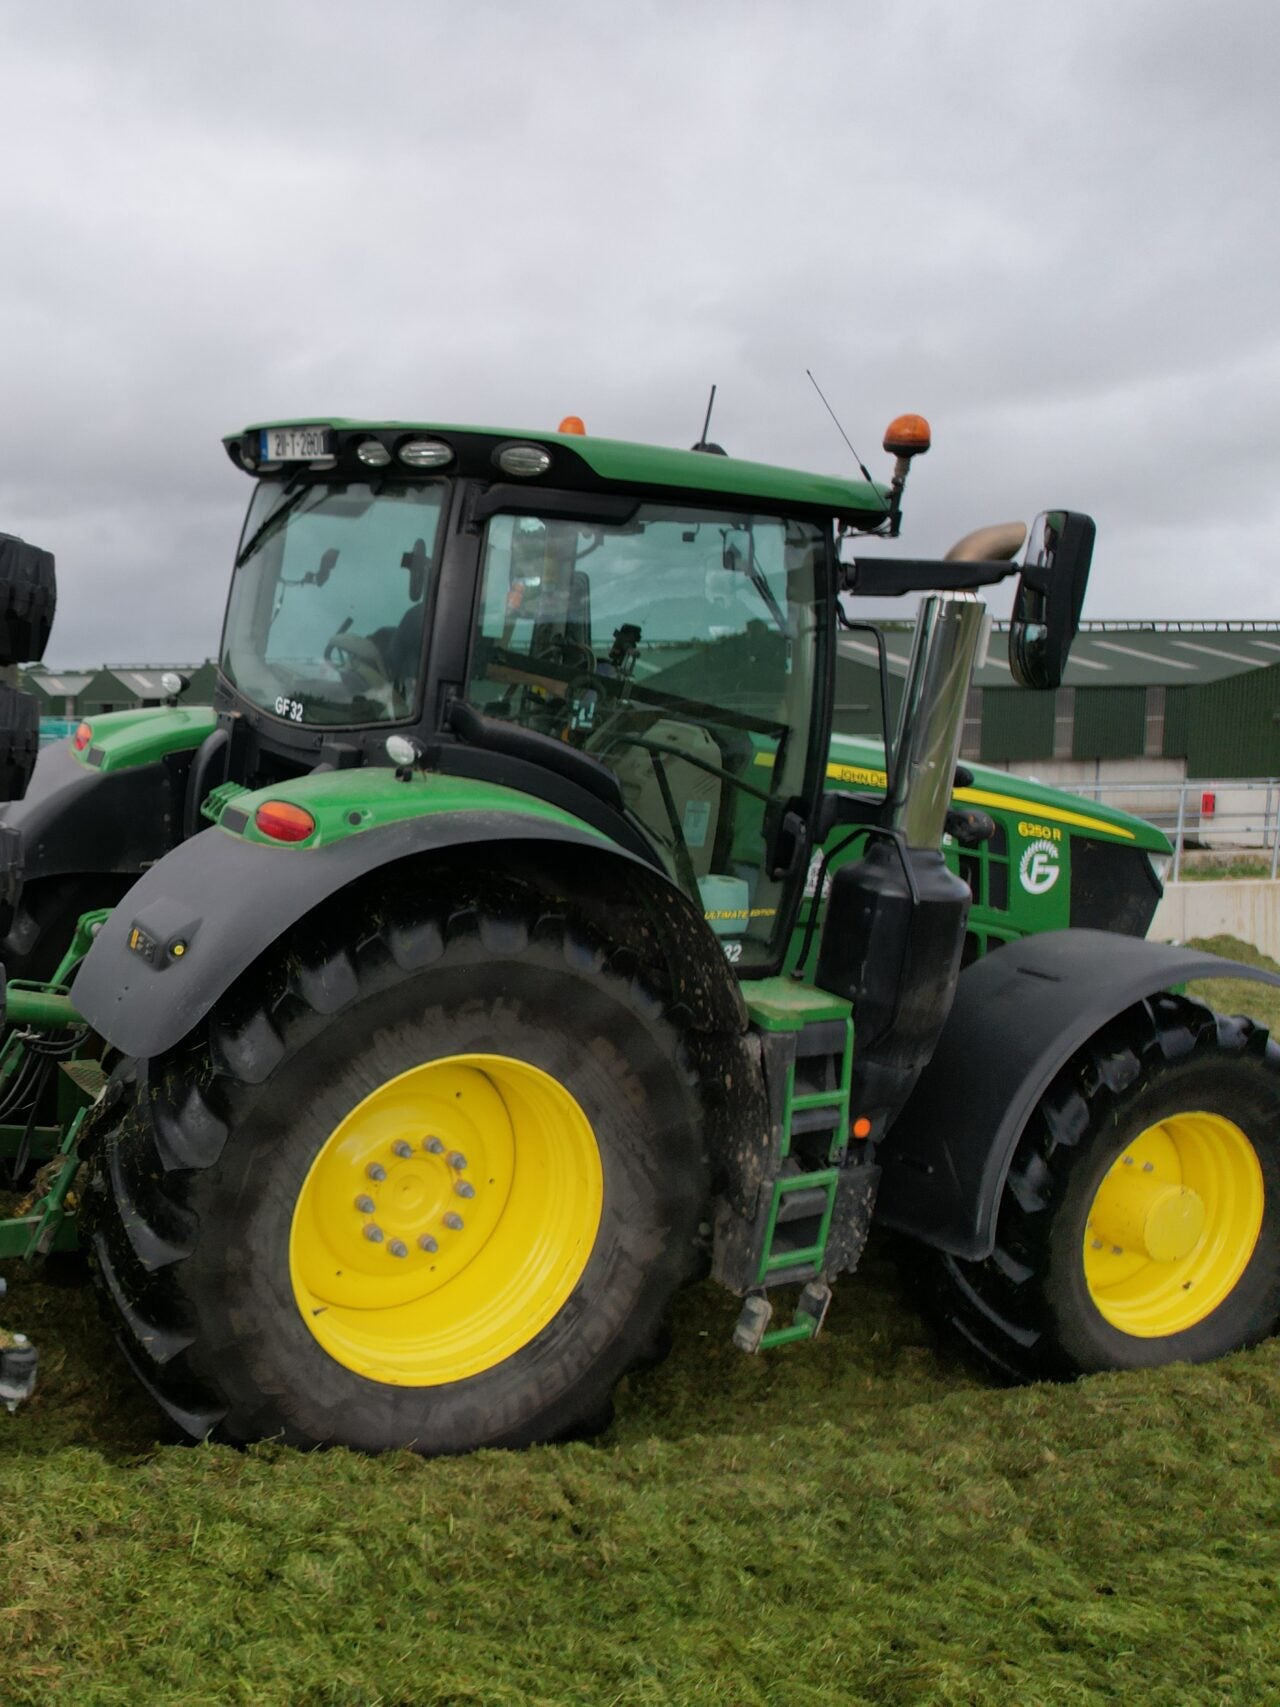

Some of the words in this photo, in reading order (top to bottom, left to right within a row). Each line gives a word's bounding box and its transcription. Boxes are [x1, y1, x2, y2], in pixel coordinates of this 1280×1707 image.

[840, 768, 868, 784] JOHN
[870, 773, 887, 786] DE
[1018, 821, 1051, 839] 6250
[1053, 827, 1061, 841] R
[704, 909, 747, 920] ULTIMATE
